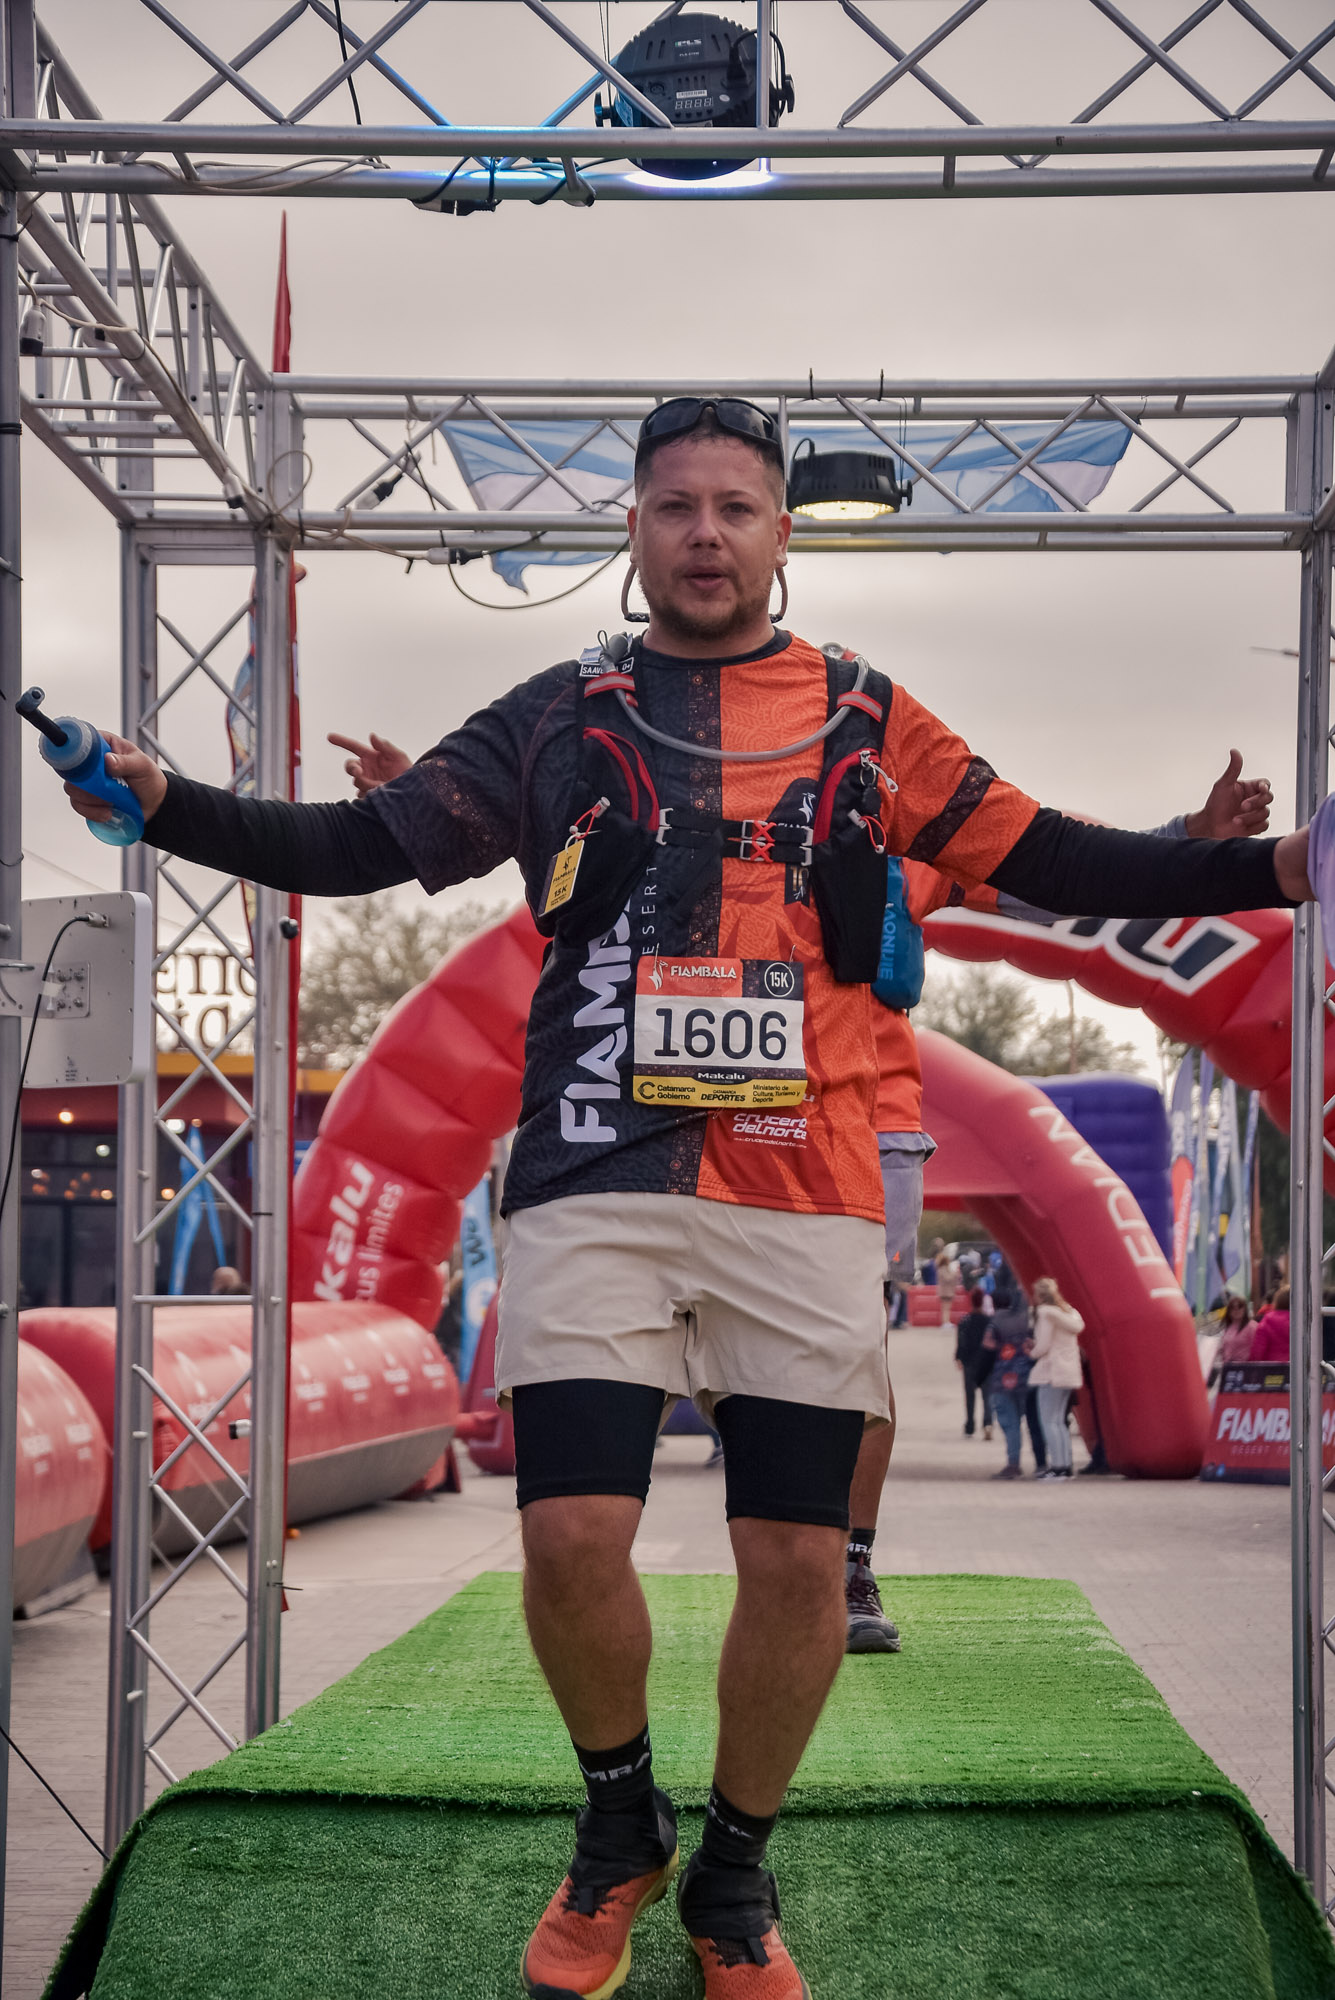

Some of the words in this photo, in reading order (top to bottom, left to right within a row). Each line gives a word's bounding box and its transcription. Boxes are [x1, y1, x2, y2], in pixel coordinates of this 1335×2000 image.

[642, 866, 657, 954] ESERT
[670, 965, 737, 979] FIAMBALA
[769, 971, 789, 988] 15K
[560, 892, 632, 1143] FIAMB
[653, 1007, 788, 1061] 1606
[697, 1072, 746, 1080] Makalu
[657, 1084, 696, 1092] Catamarca
[657, 1092, 691, 1100] Gobierno
[700, 1093, 746, 1102] DEPORTES
[752, 1096, 774, 1104] Deporte
[733, 1112, 808, 1129] crucero
[313, 1160, 376, 1302] kalu
[1216, 1407, 1291, 1444] FIAMB
